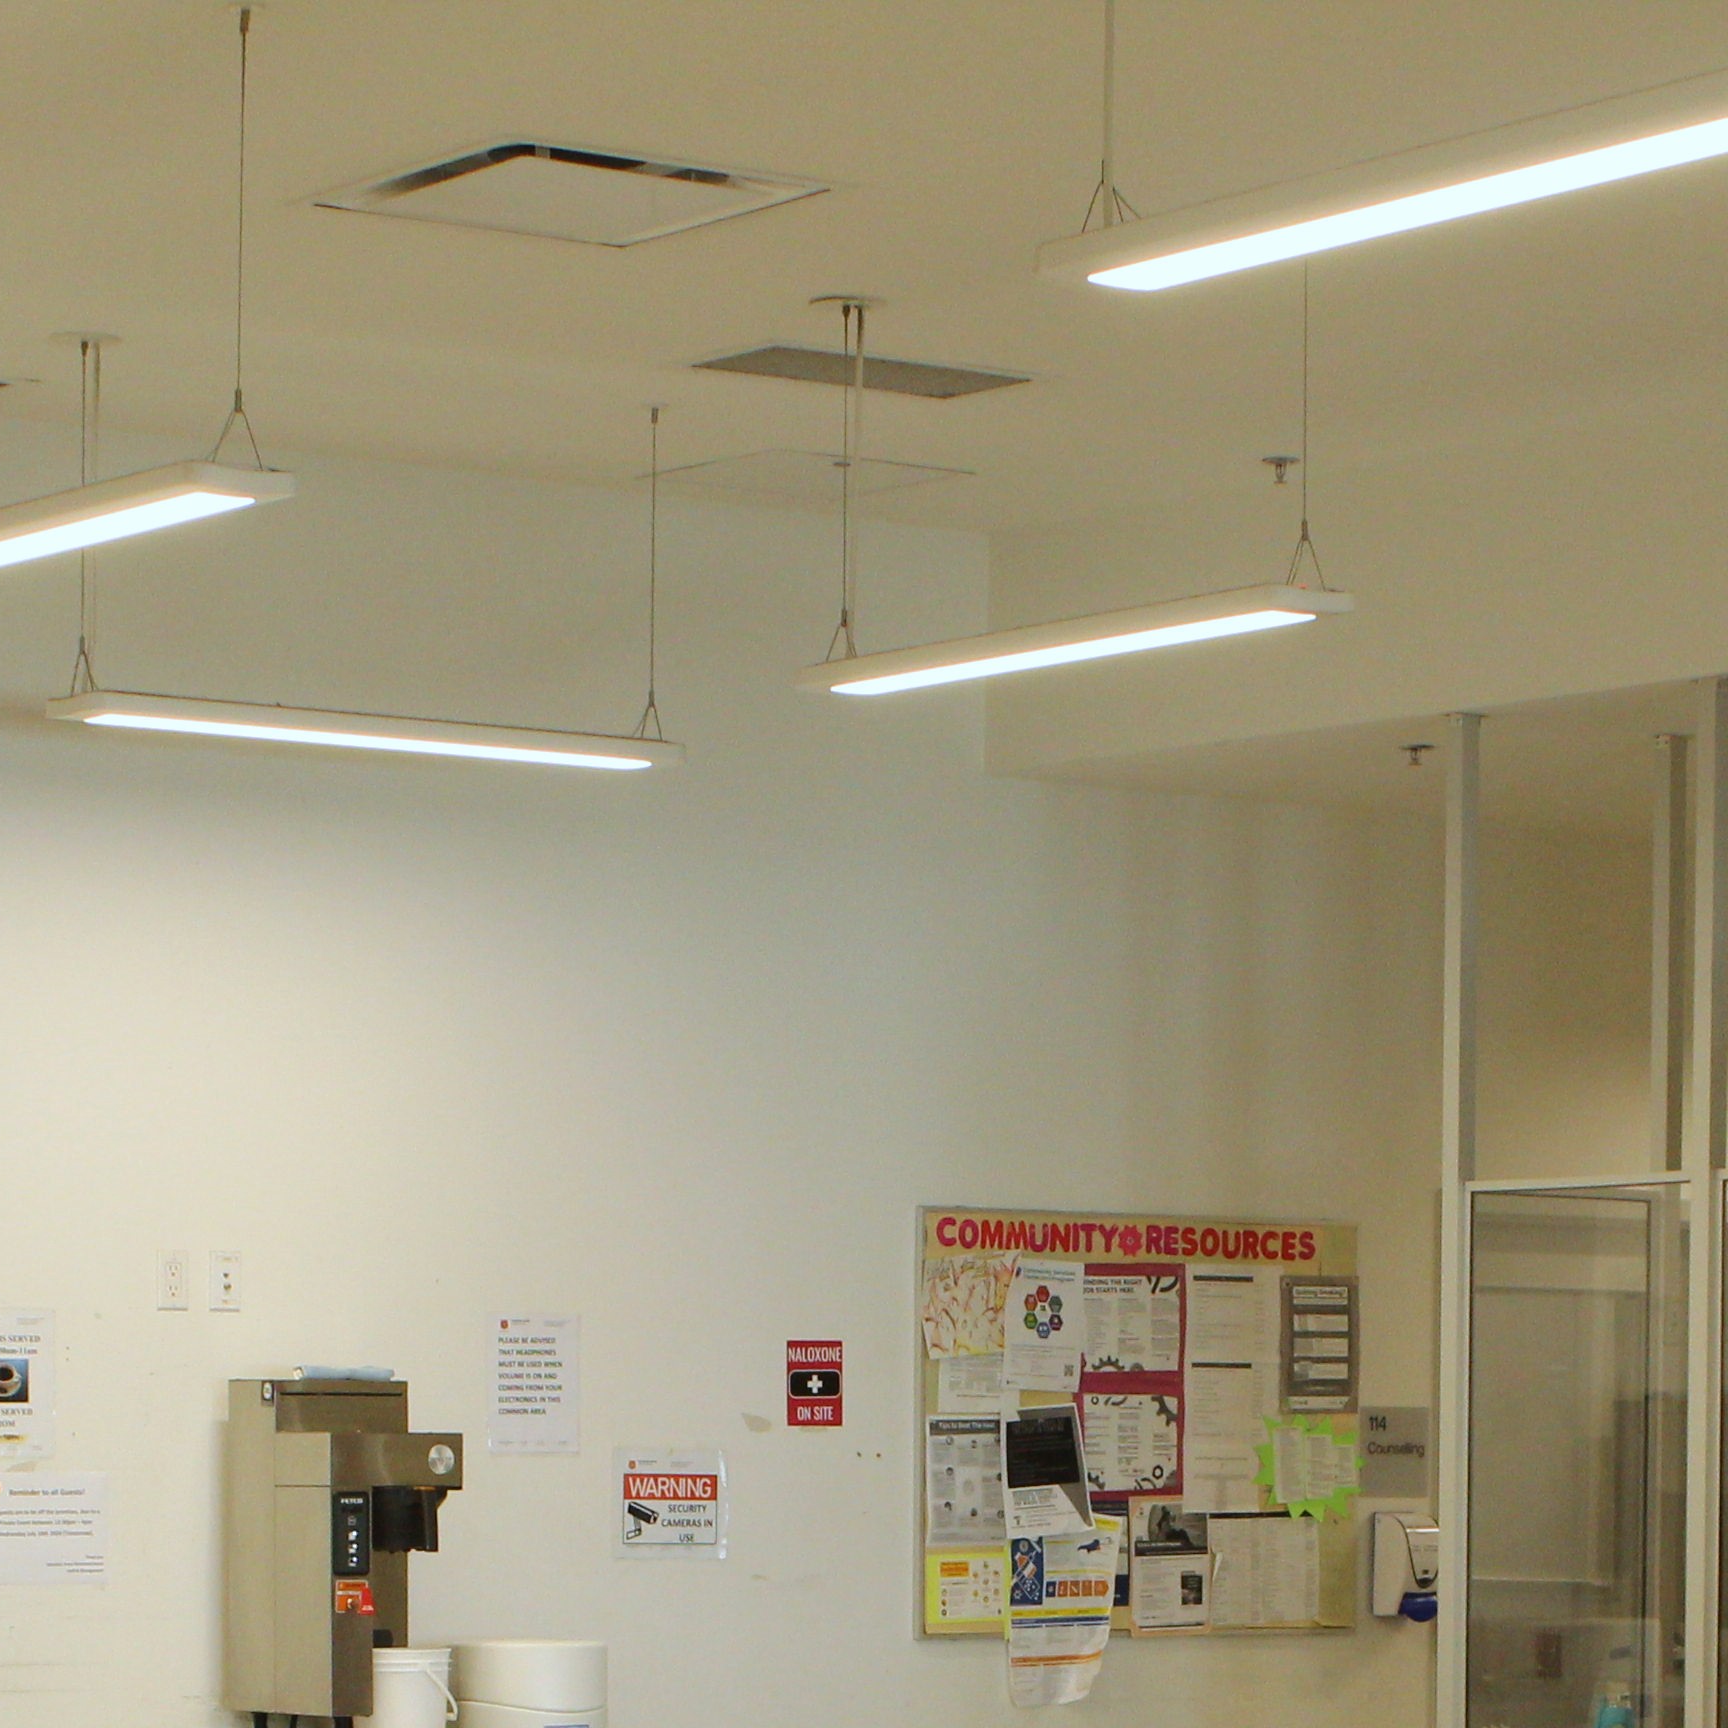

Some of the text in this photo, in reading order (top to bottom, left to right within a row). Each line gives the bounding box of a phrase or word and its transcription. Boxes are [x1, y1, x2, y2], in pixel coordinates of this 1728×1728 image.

[936, 1216, 1316, 1261] COMMUNITY RESOURCES
[788, 1347, 842, 1362] NALOXONE
[2, 1408, 33, 1416] SERVED
[797, 1406, 833, 1421] ON SITE
[1369, 1415, 1387, 1431] 114
[1367, 1441, 1425, 1458] Counselling
[9, 1488, 40, 1496] Reminder
[628, 1477, 712, 1498] WARNING
[668, 1504, 707, 1513] SECURITY
[661, 1519, 713, 1528] CAMERAS IN
[679, 1533, 695, 1542] USE
